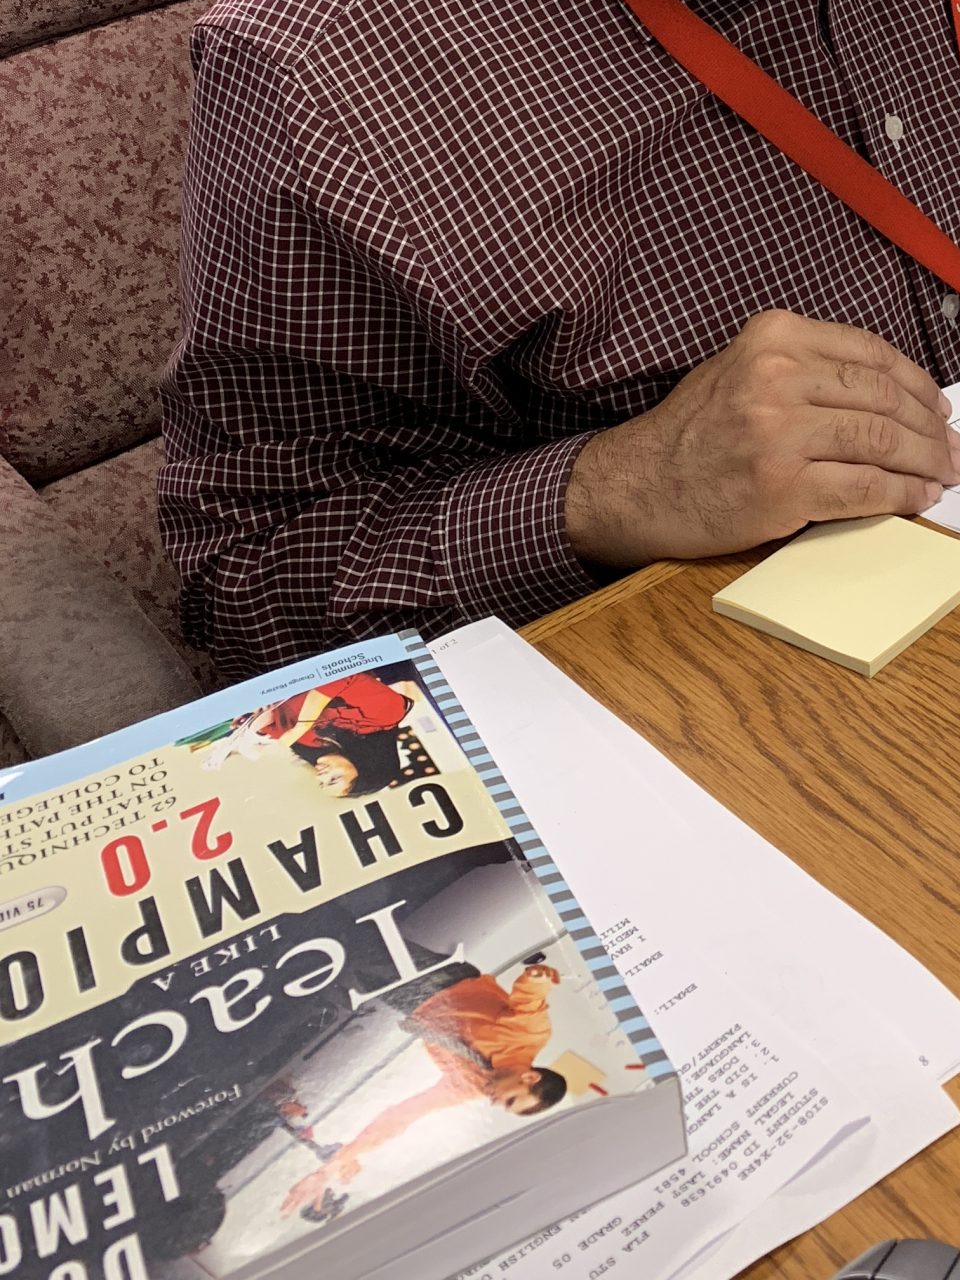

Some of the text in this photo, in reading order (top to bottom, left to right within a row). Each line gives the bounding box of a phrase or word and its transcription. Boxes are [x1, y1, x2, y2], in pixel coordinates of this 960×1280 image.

[321, 652, 366, 671] Schools
[324, 655, 384, 677] Uncommon
[0, 757, 164, 823] TO COLLEGE
[131, 770, 168, 791] ON
[68, 789, 124, 816] THE
[102, 783, 174, 820] THAT
[151, 796, 177, 813] 62
[41, 814, 93, 843] PUT
[100, 796, 234, 897] 2.0
[0, 782, 464, 1021] CHAMPIO
[27, 897, 45, 912] 75
[150, 923, 283, 993] LIKE A
[654, 983, 697, 1014] EMAIL:
[4, 899, 466, 1141] Teach
[688, 1031, 750, 1080] LANGUAGE:
[707, 1056, 740, 1083] DOES
[724, 1063, 749, 1085] DID
[741, 1072, 758, 1087] IS
[694, 1089, 719, 1110] THE
[754, 1091, 794, 1125] LEGAL
[7, 1083, 242, 1199] Foreword by Norman
[654, 1071, 798, 1193] CURRENT SCHOOL 4581
[680, 1088, 818, 1207] STUDENT ID 0491638
[713, 1130, 751, 1162] NAME:
[672, 1171, 705, 1198] LAST
[621, 1201, 664, 1236] PEREZ
[498, 1222, 561, 1270] ENGLISH
[552, 1217, 622, 1269] GRADE 05
[622, 1230, 650, 1252] FLA
